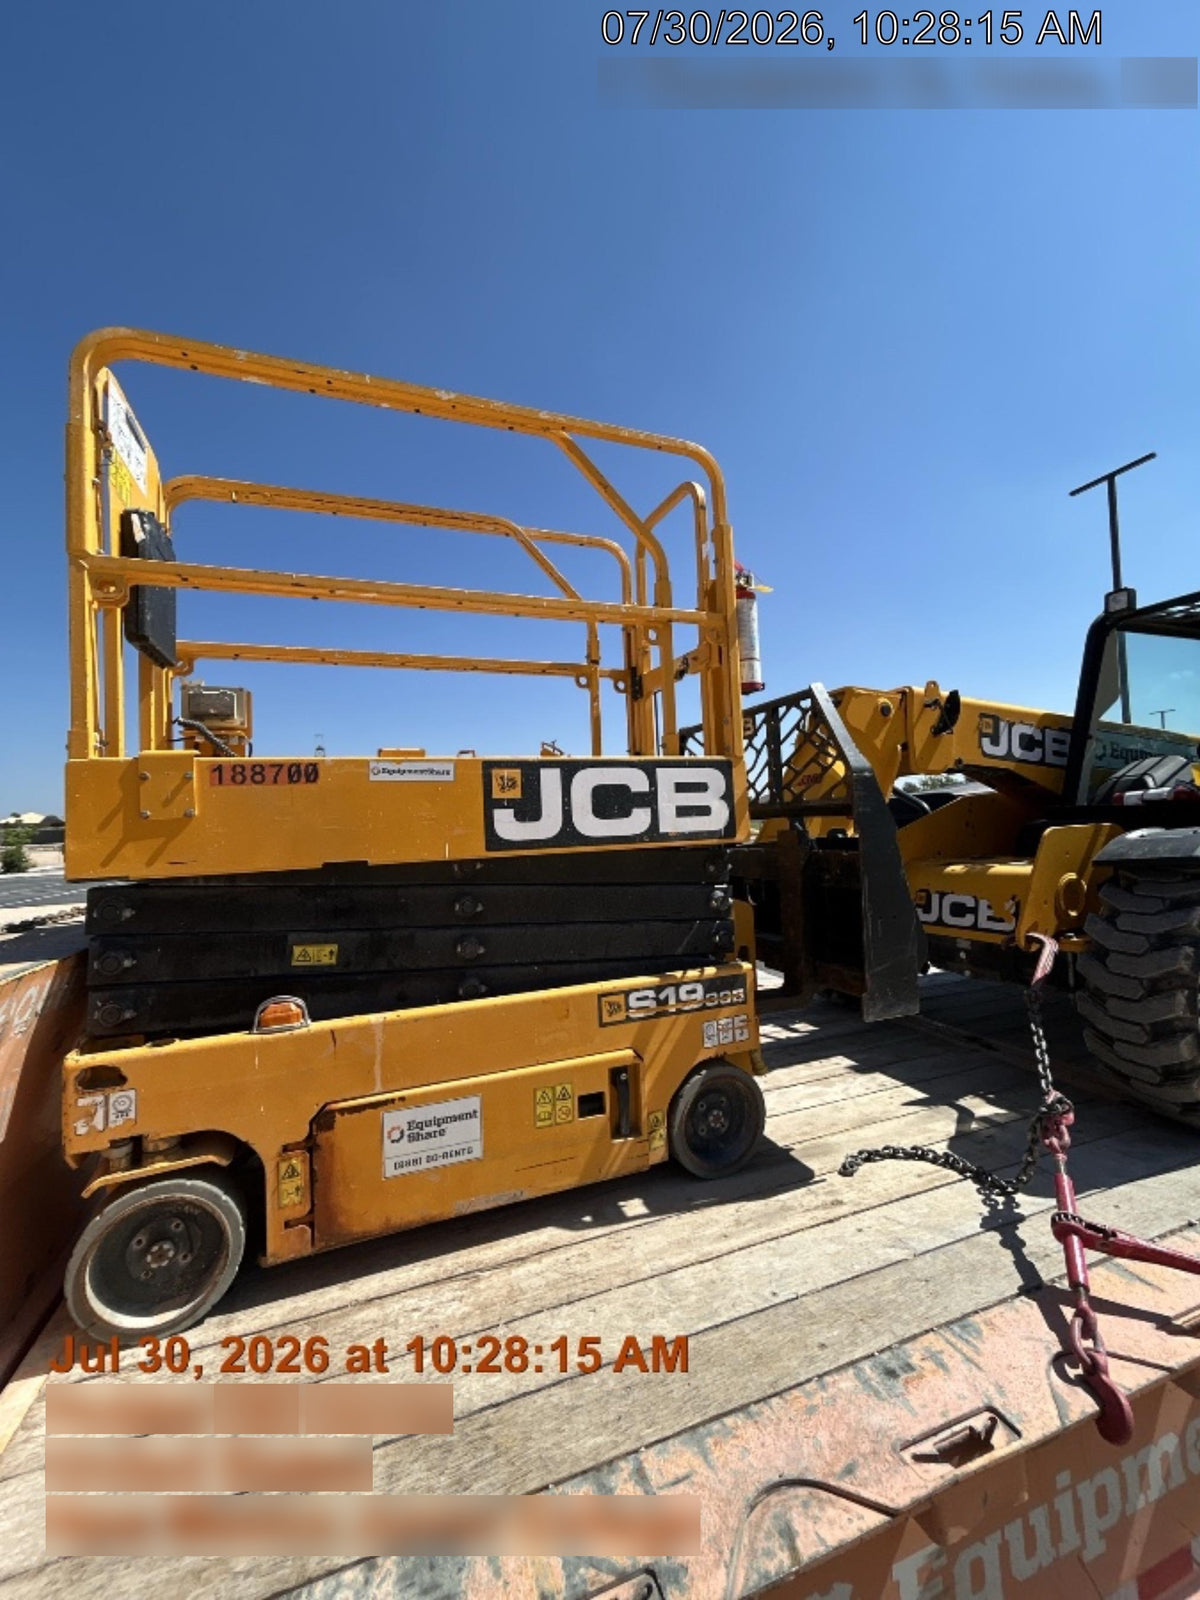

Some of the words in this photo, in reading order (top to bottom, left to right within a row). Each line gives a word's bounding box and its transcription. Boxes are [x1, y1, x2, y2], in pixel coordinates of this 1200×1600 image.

[981, 721, 1070, 764] JCB
[211, 763, 319, 785] 188700
[493, 766, 730, 841] JCB
[406, 1109, 479, 1131] Equipment
[407, 1128, 446, 1143] Share
